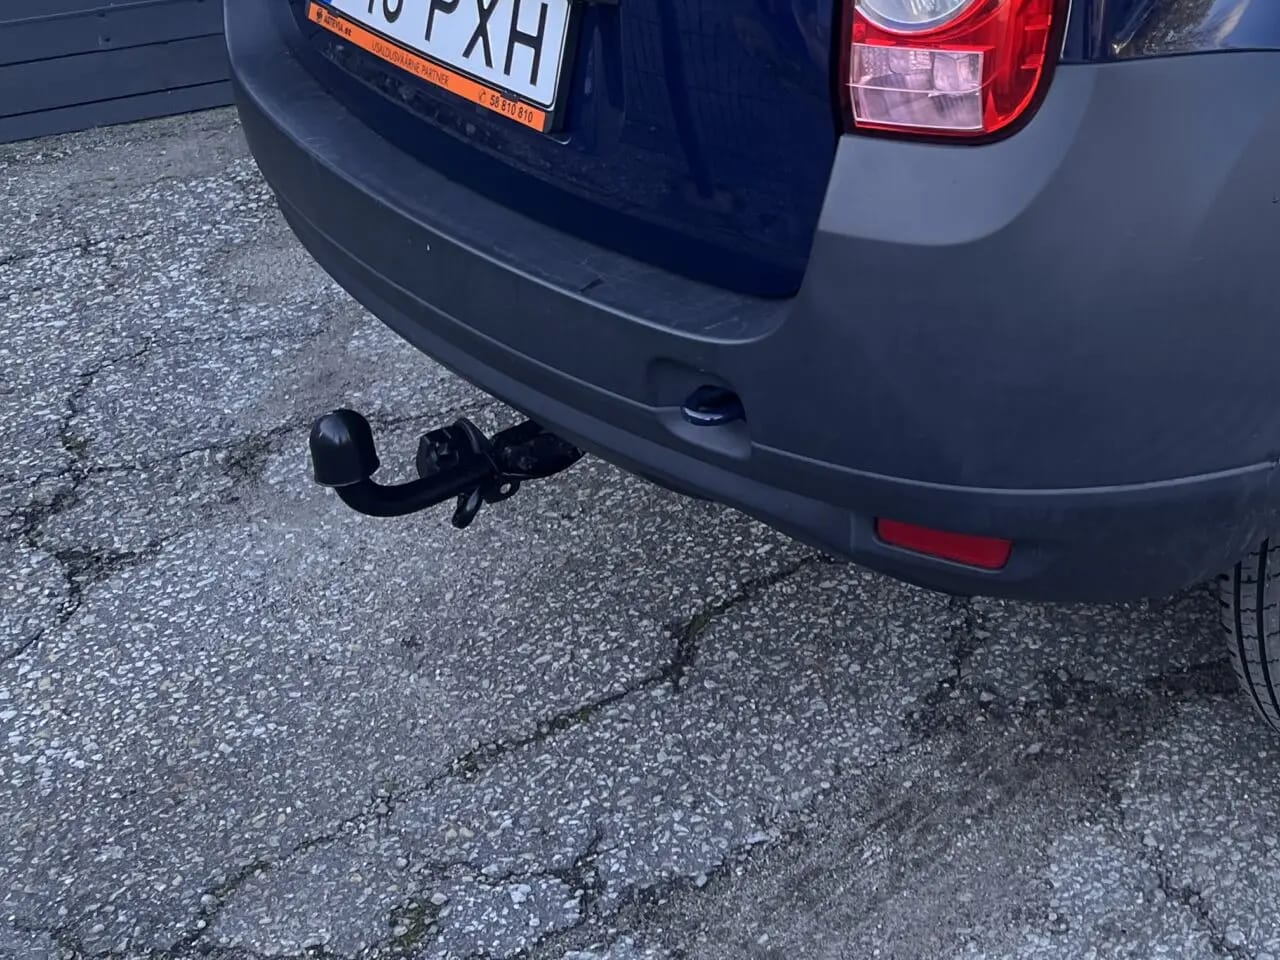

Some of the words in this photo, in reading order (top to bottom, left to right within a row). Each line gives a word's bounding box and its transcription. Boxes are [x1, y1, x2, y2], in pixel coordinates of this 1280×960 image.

[489, 95, 500, 109] 58
[500, 99, 516, 116] 810
[517, 107, 534, 123] 810
